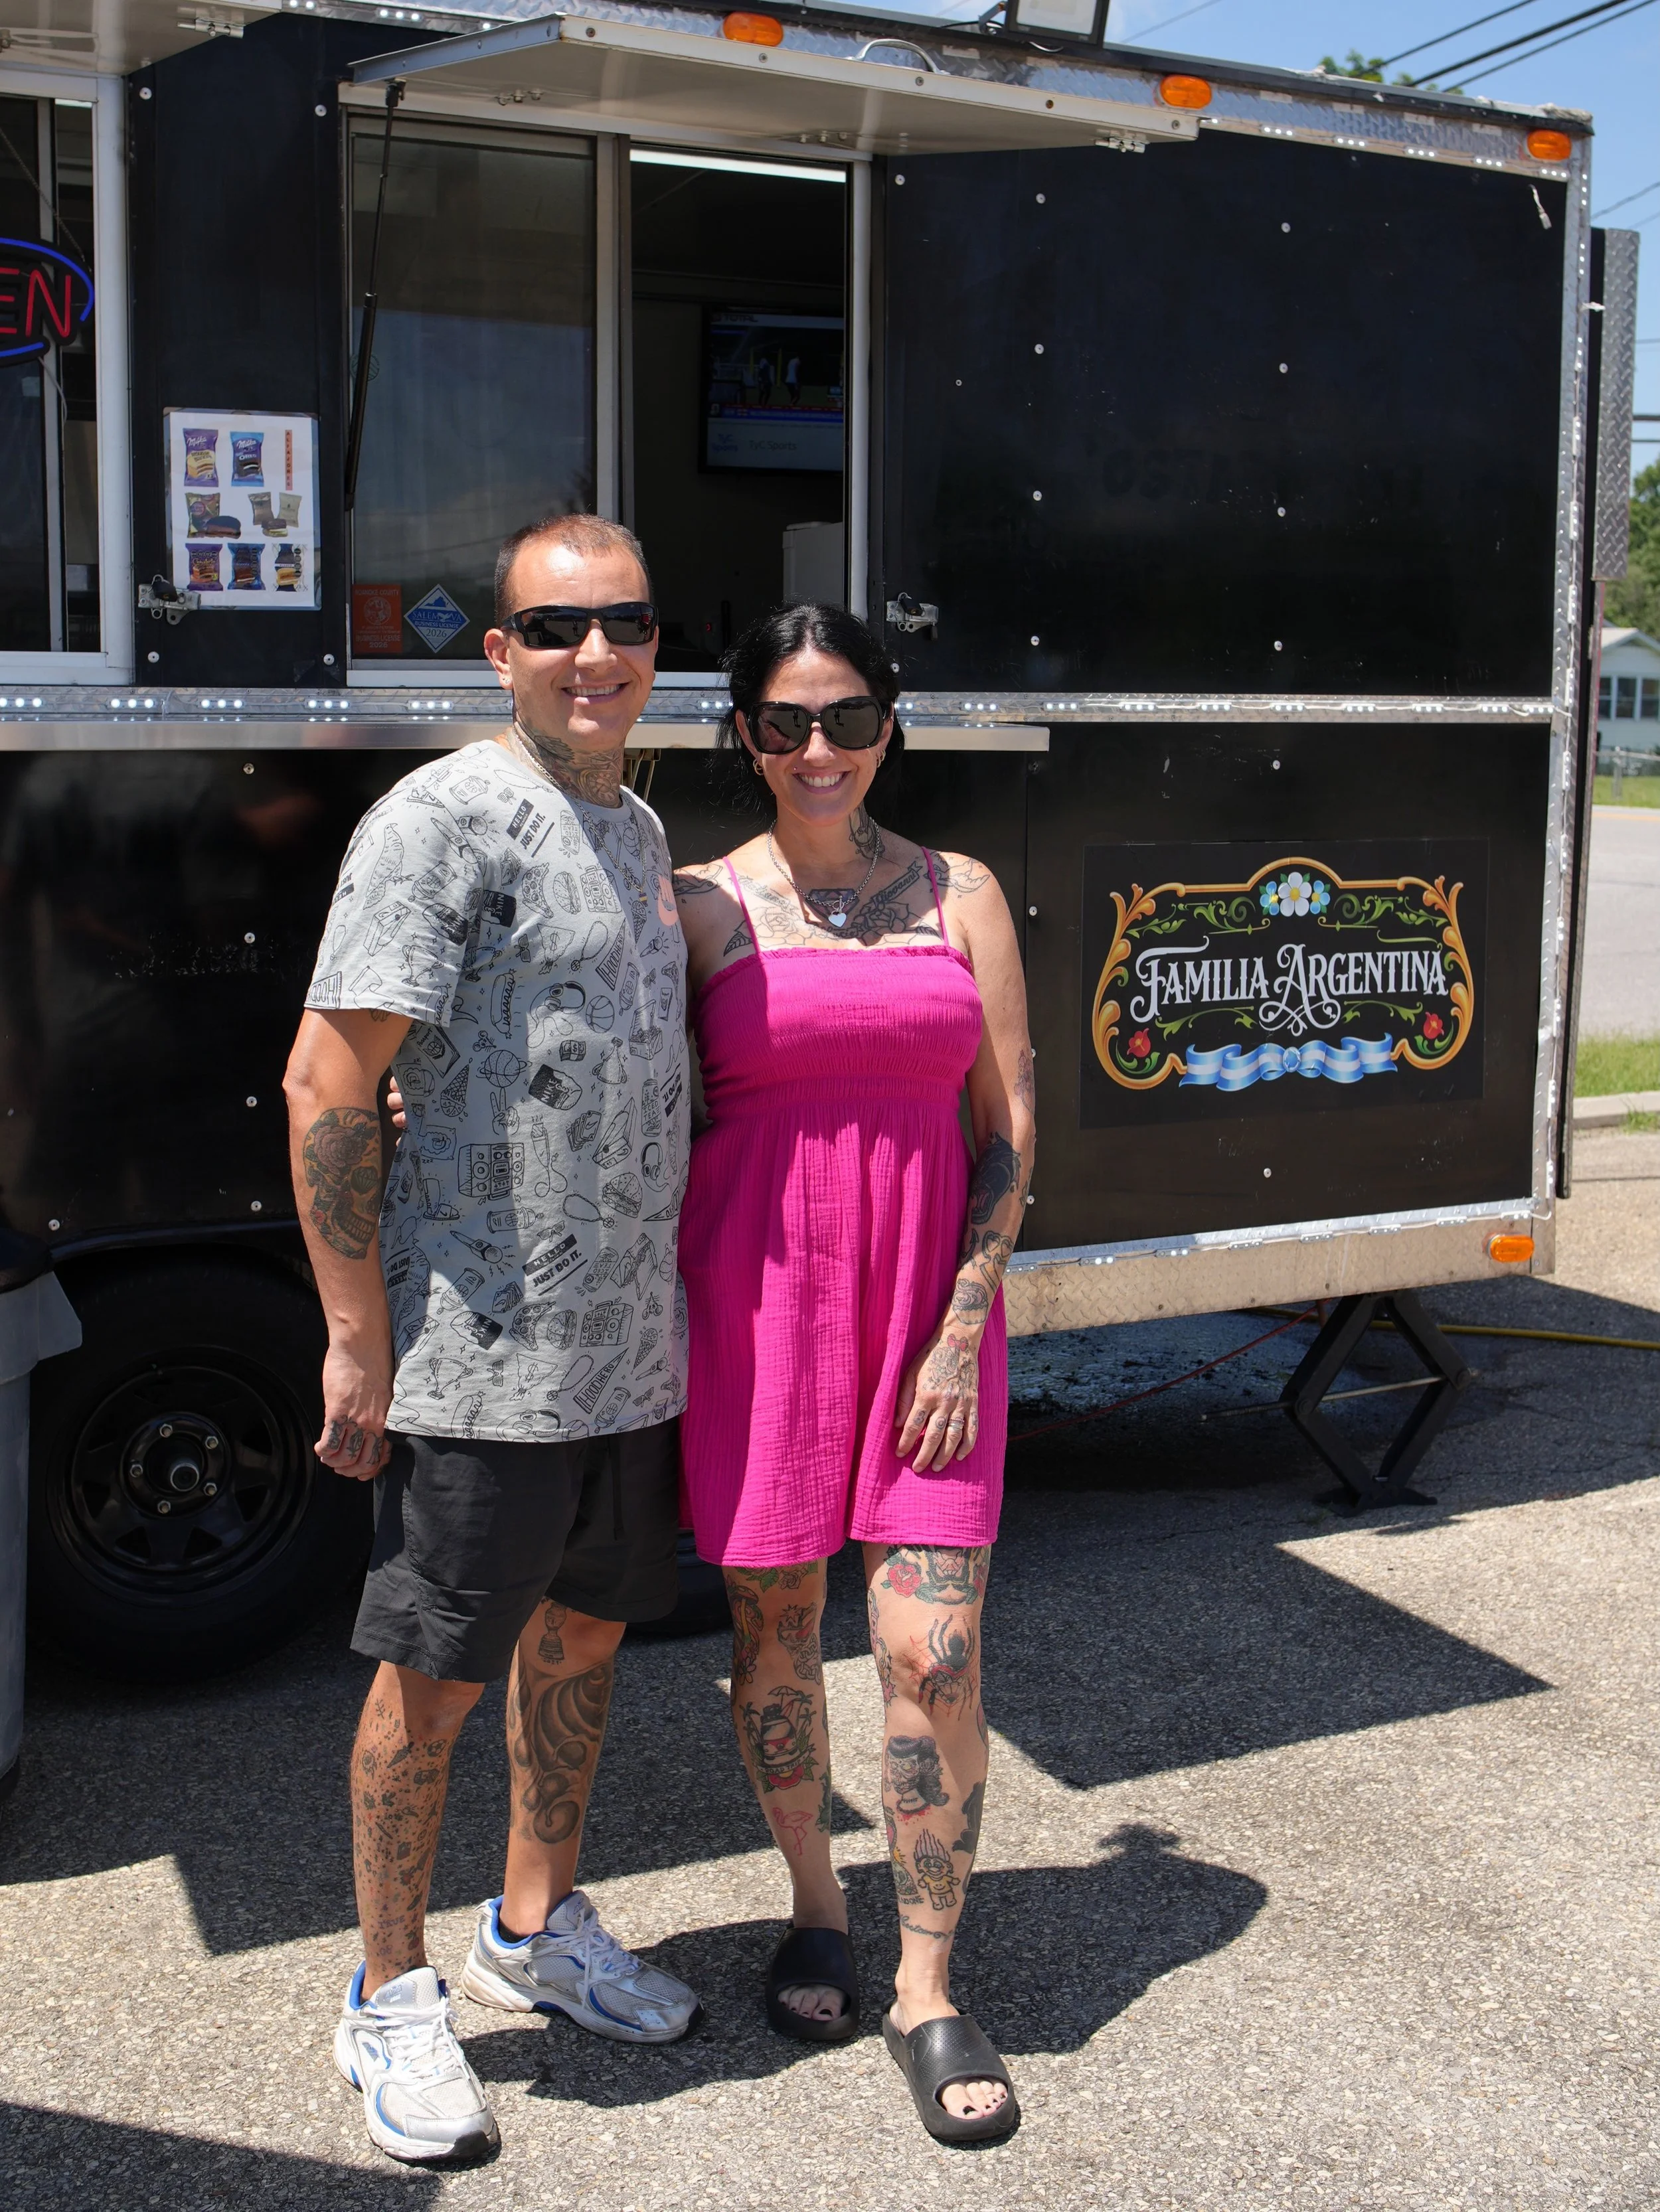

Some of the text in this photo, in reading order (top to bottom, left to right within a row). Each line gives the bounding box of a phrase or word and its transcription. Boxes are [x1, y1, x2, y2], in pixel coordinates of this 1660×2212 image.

[236, 439, 257, 449] Milka
[768, 441, 797, 451] Sports
[412, 611, 440, 620] SALEM
[426, 628, 447, 638] 2026
[512, 806, 527, 829] HELLO
[520, 830, 535, 850] JUST
[529, 820, 540, 834] DO
[535, 813, 546, 823] IT.
[494, 894, 505, 915] NIKE
[601, 934, 623, 983] HOODHERO
[1130, 935, 1450, 1036] FAMILIA ARGENTINA
[540, 1078, 557, 1102] NIKE
[643, 1101, 659, 1114] ICED
[643, 1110, 657, 1121] TEA
[533, 1243, 566, 1266] HELLO
[533, 1269, 554, 1287] JUST
[555, 1258, 570, 1273] DO
[570, 1249, 582, 1261] IT.
[476, 1318, 492, 1338] NIKE
[579, 1364, 614, 1407] HOODHERO
[787, 1759, 801, 1770] TRIP
